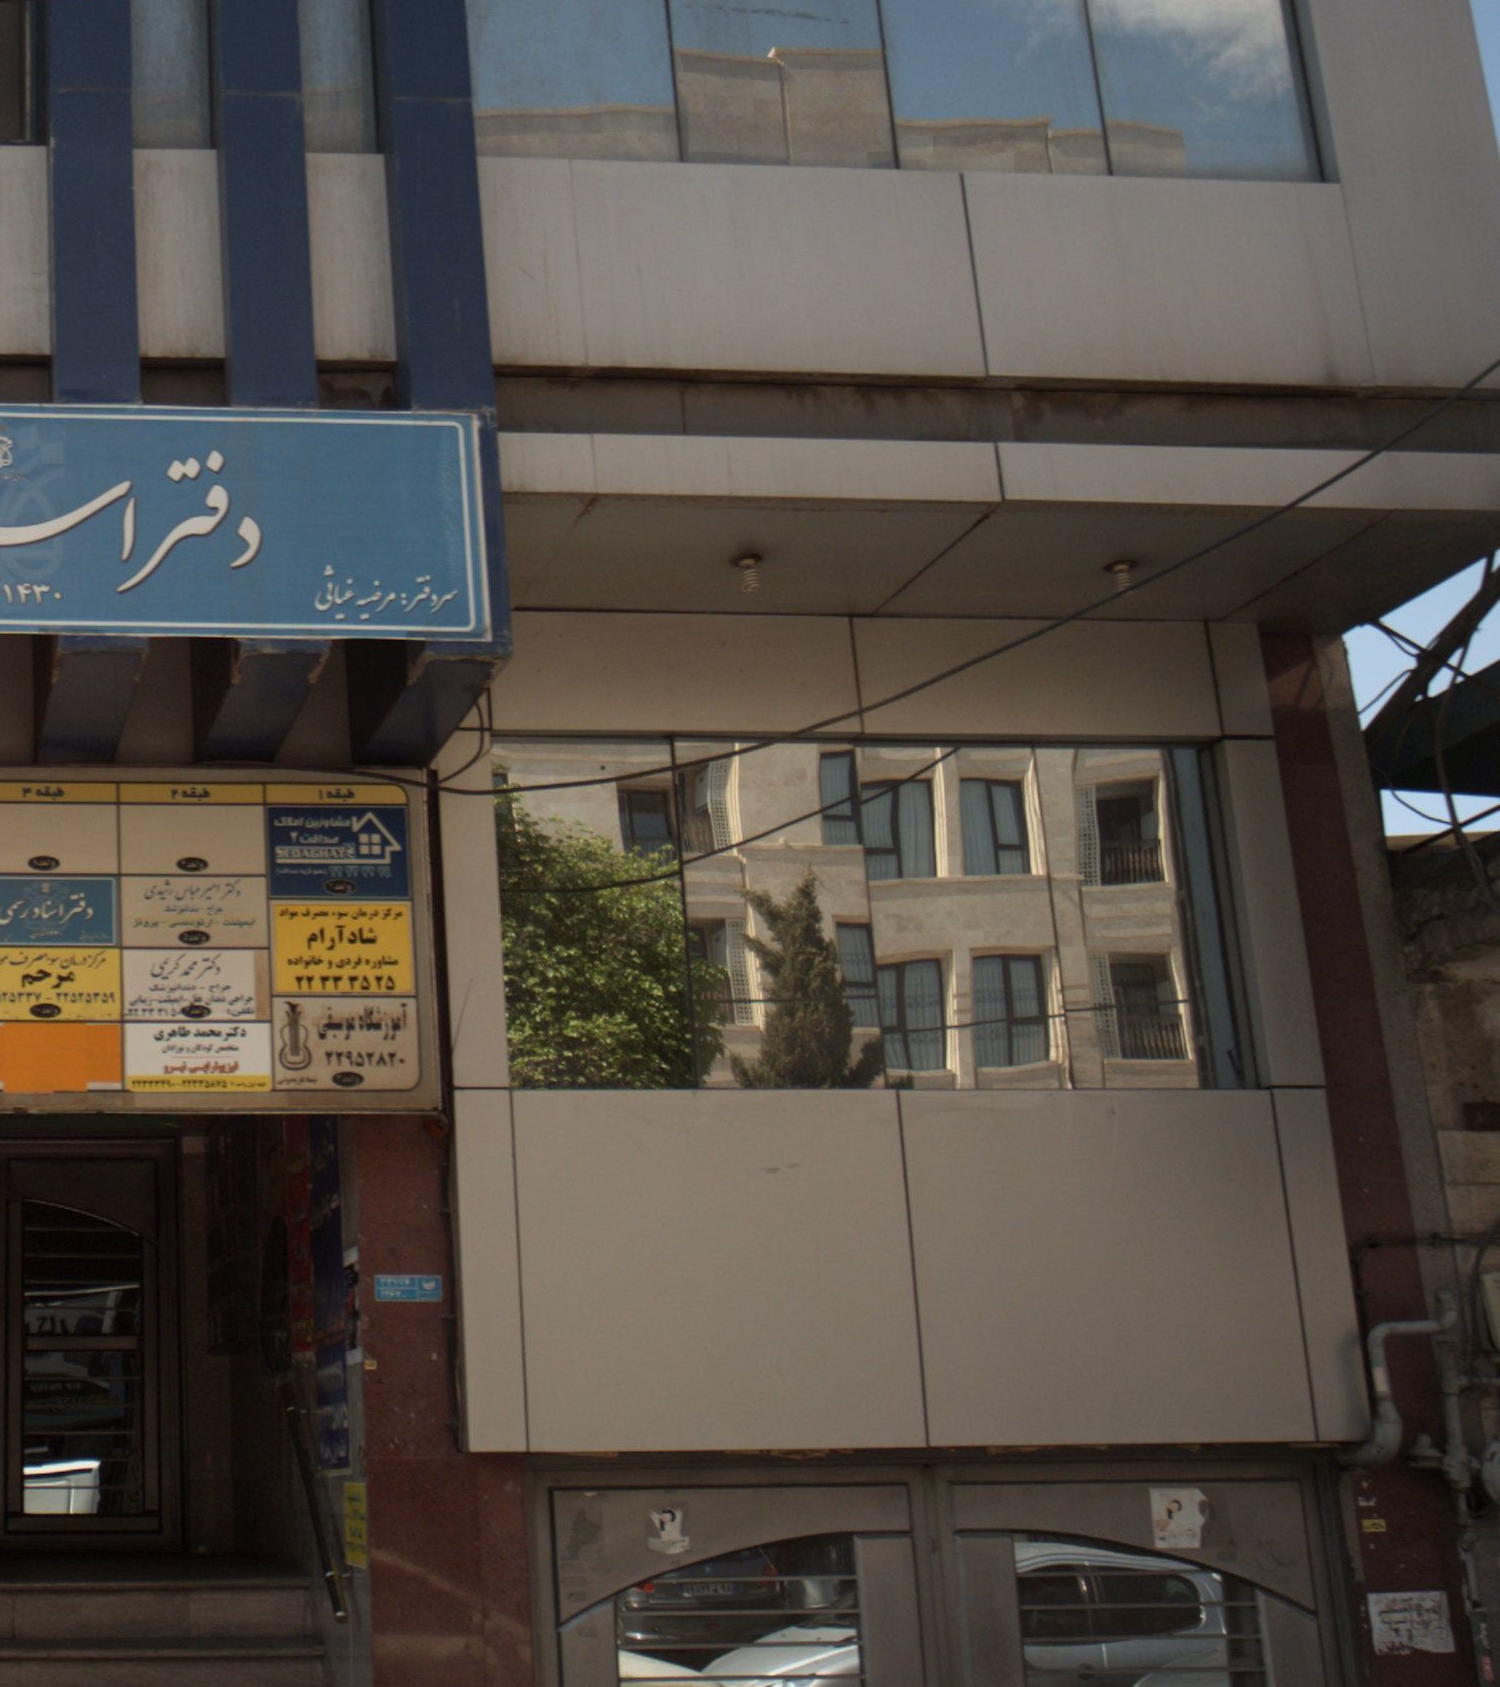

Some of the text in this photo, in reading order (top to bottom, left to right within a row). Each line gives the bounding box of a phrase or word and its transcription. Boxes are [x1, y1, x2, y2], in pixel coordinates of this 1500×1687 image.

[116, 449, 263, 593] دفتر
[3, 582, 63, 605] ۱۴۳۰
[314, 564, 356, 621] غیاثی
[355, 579, 397, 621] مرضیه
[35, 787, 65, 799] طبقه
[181, 788, 211, 800] طبقه
[325, 788, 356, 800] طبقه
[32, 899, 65, 920] اسناد
[59, 891, 95, 925] دفتر
[279, 908, 298, 920] مواد
[301, 908, 329, 920] مصرف
[351, 908, 378, 921] درمان
[381, 908, 403, 920] مرکز
[194, 952, 222, 981] دکتر
[287, 955, 324, 969] خانواده
[334, 955, 361, 969] فردی
[364, 955, 399, 969] مشاوره
[153, 1026, 247, 1042] دکتر محمد طاهری
